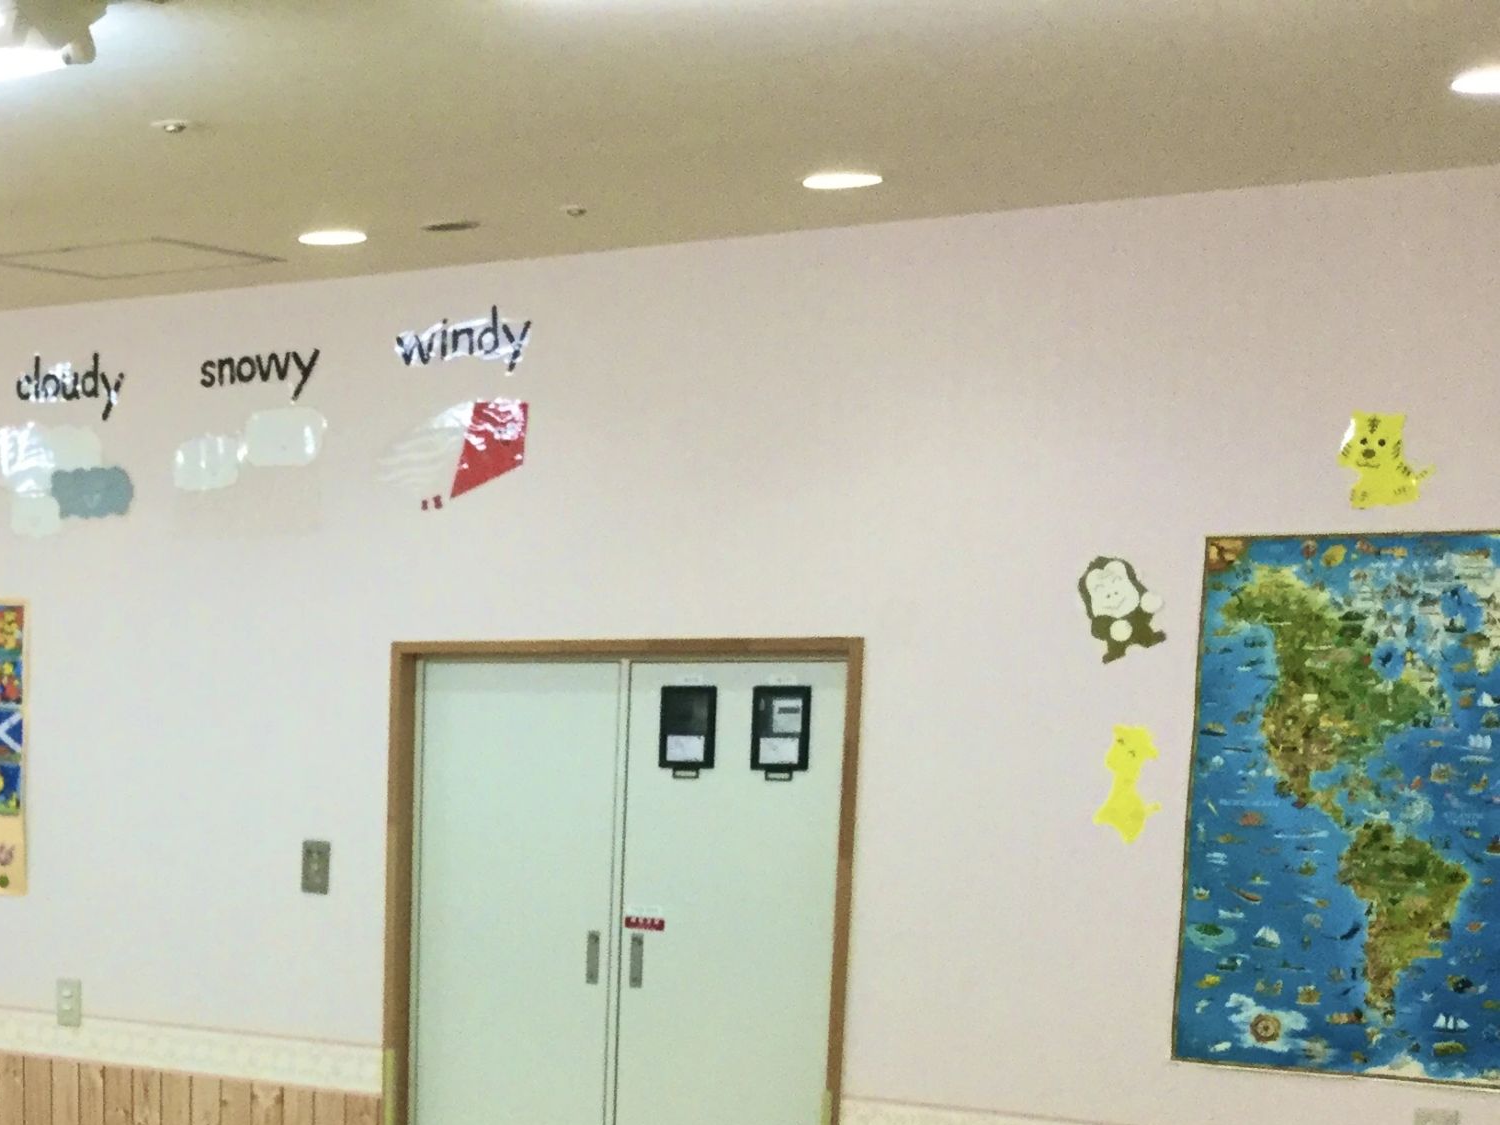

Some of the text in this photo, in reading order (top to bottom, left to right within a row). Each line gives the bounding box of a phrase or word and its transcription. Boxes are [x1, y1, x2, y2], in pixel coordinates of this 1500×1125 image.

[397, 305, 532, 371] windy
[16, 354, 125, 421] cloudy
[199, 349, 320, 402] snowy
